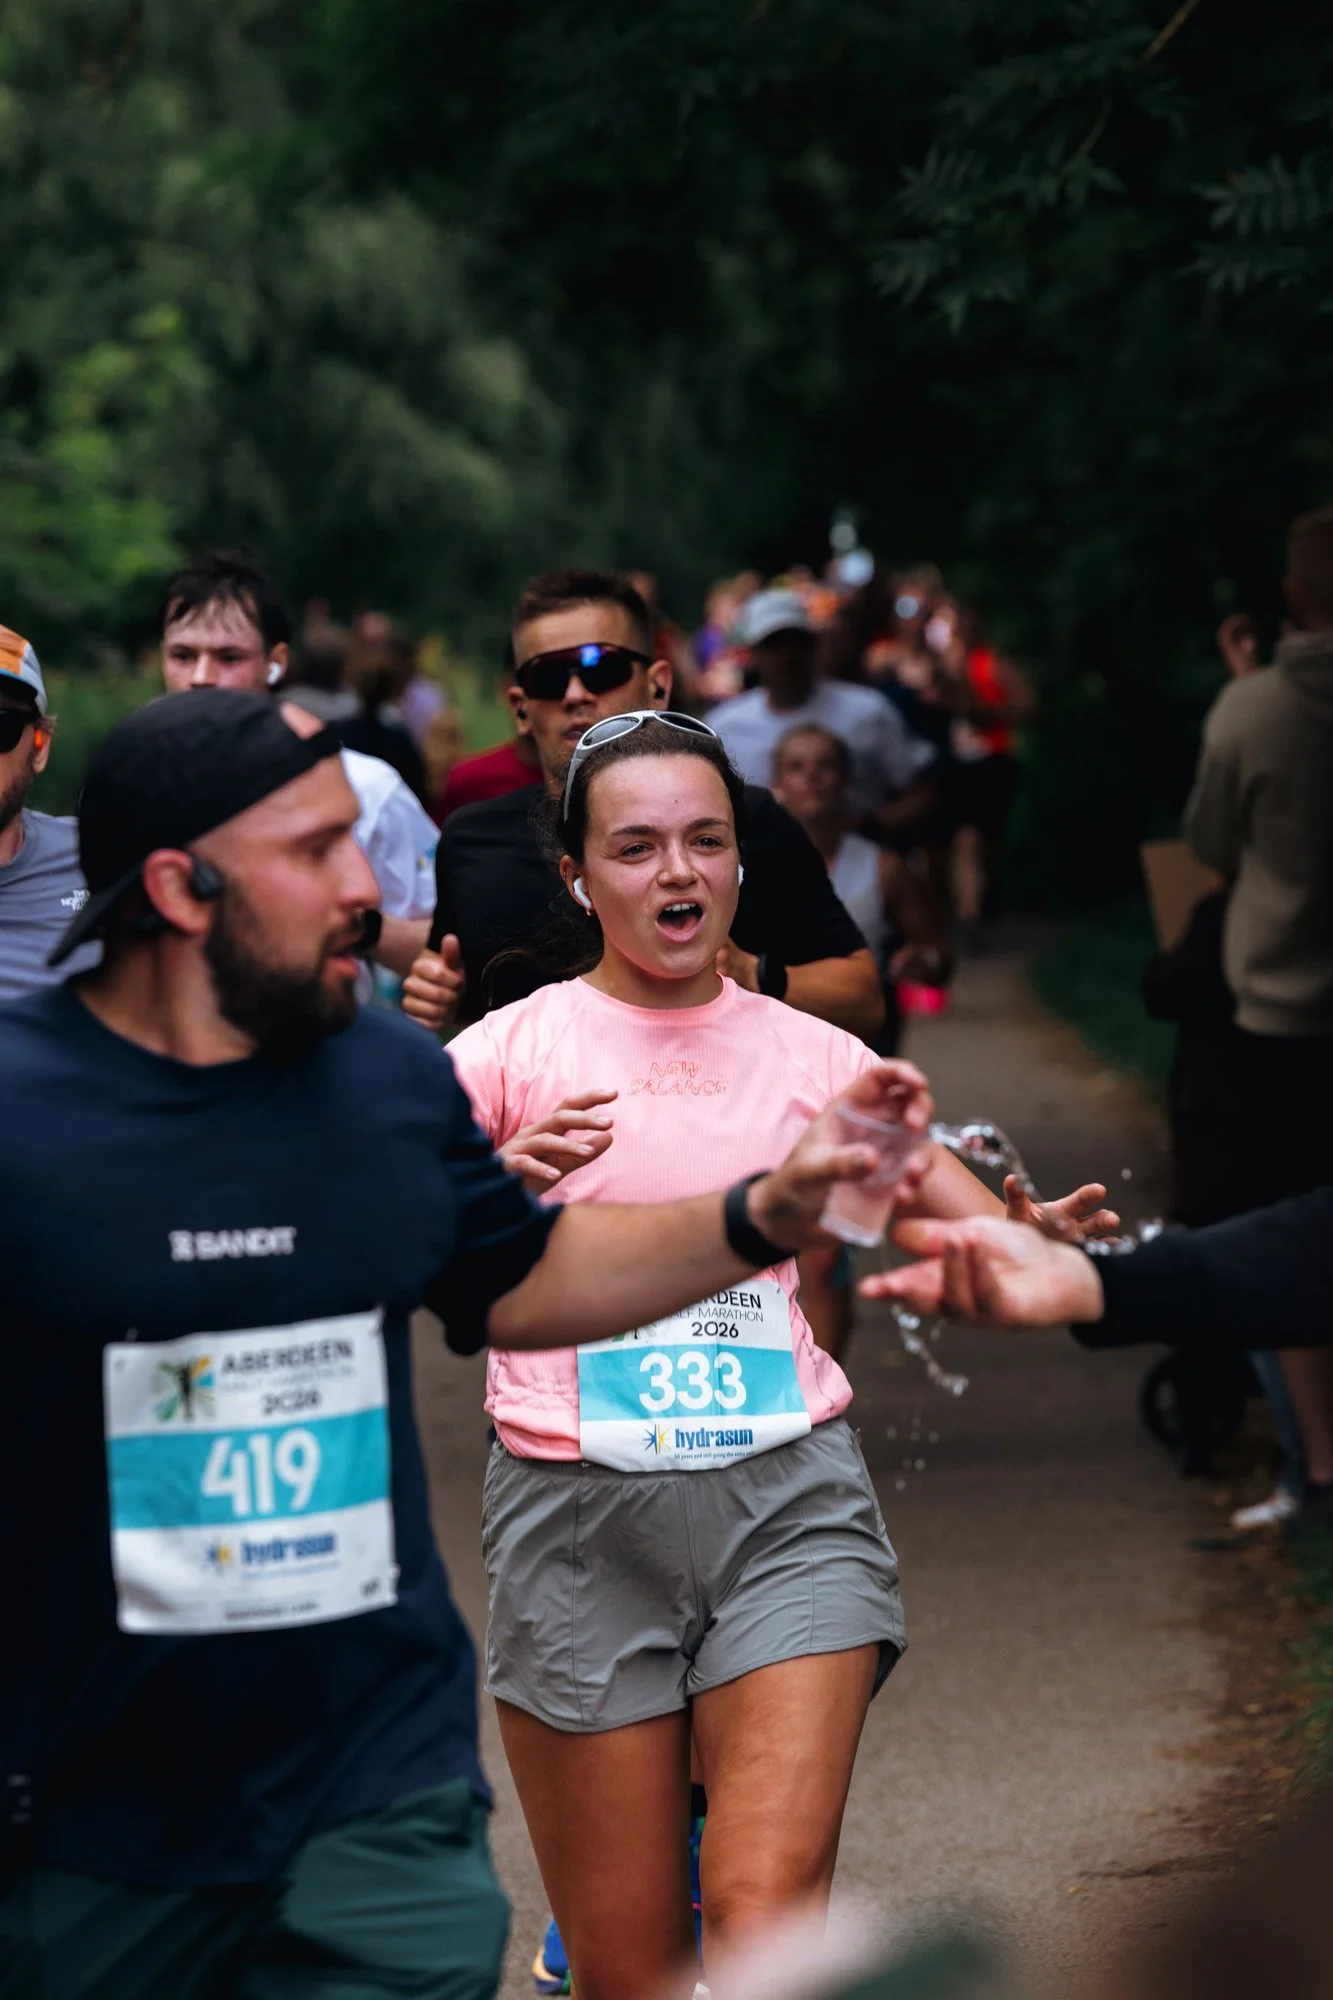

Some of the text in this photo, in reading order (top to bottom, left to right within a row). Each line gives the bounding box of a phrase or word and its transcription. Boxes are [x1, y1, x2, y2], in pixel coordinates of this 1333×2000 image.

[650, 1060, 702, 1078] NEW
[628, 1079, 728, 1096] BALANCE
[698, 1307, 764, 1322] MARATHON
[691, 1321, 739, 1338] 2026
[639, 1350, 747, 1412] 333
[675, 1427, 754, 1450] hydrasun
[202, 1428, 322, 1516] 419
